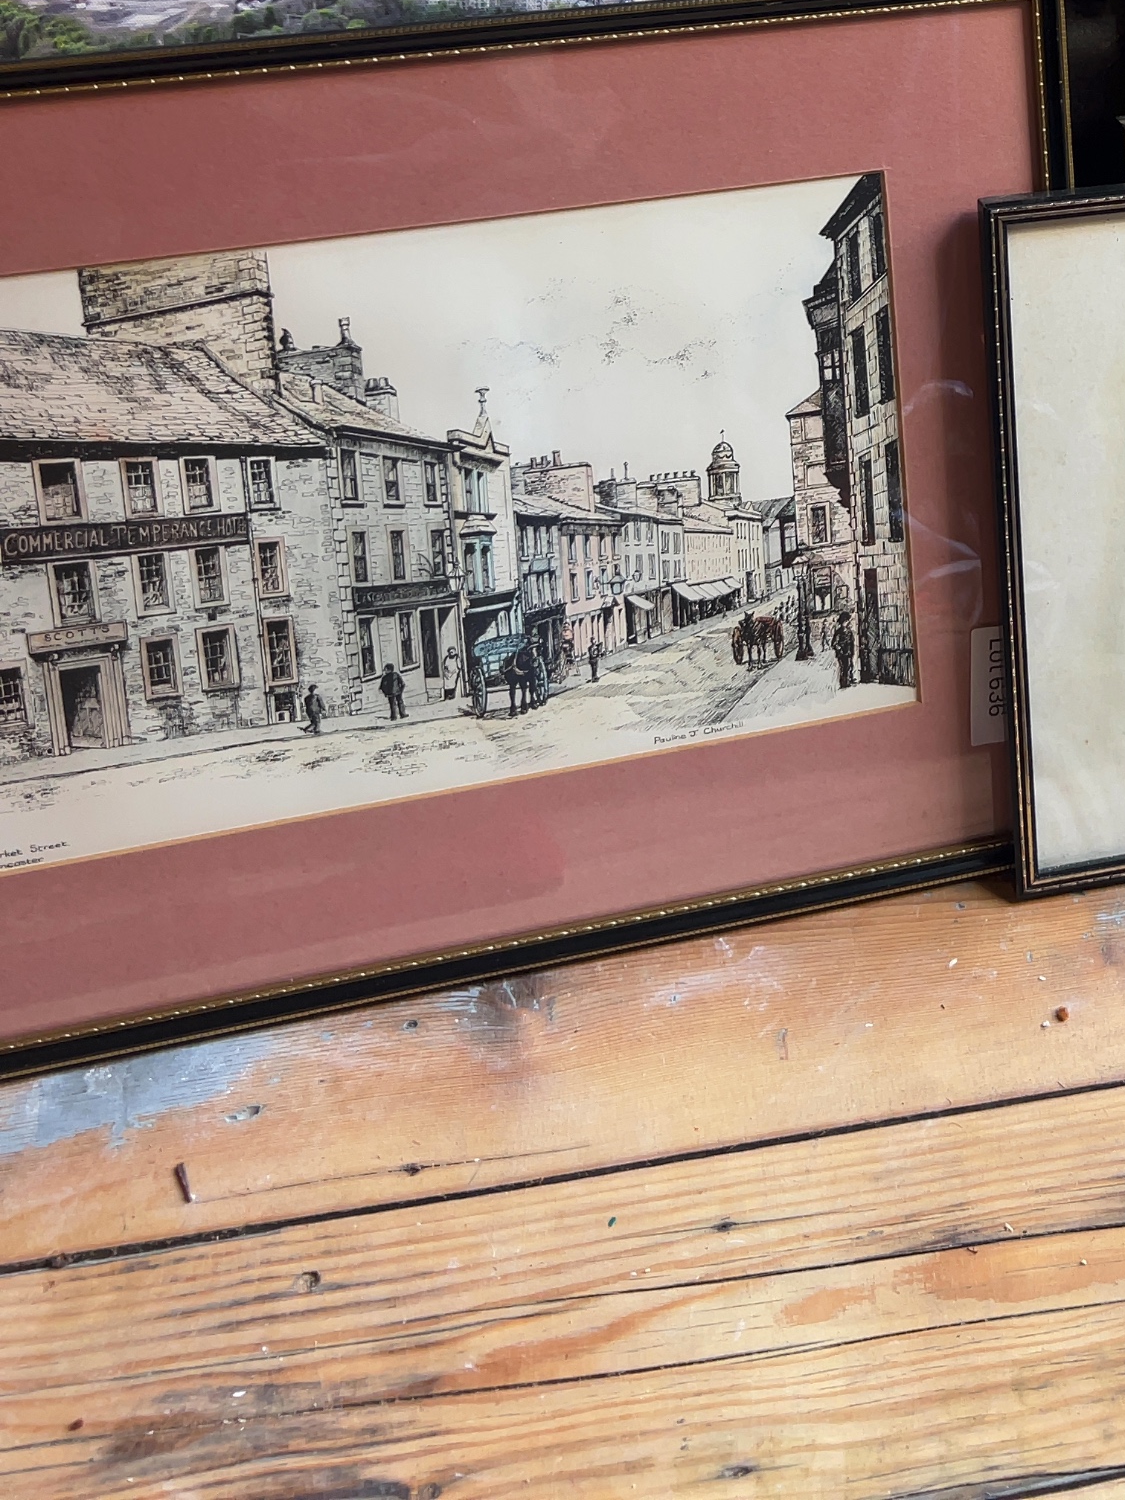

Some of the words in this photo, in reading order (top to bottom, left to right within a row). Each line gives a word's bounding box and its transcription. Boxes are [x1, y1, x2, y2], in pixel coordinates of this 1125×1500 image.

[4, 530, 110, 557] COMMERCIAL
[653, 733, 687, 745] Pauline
[30, 841, 69, 852] Street
